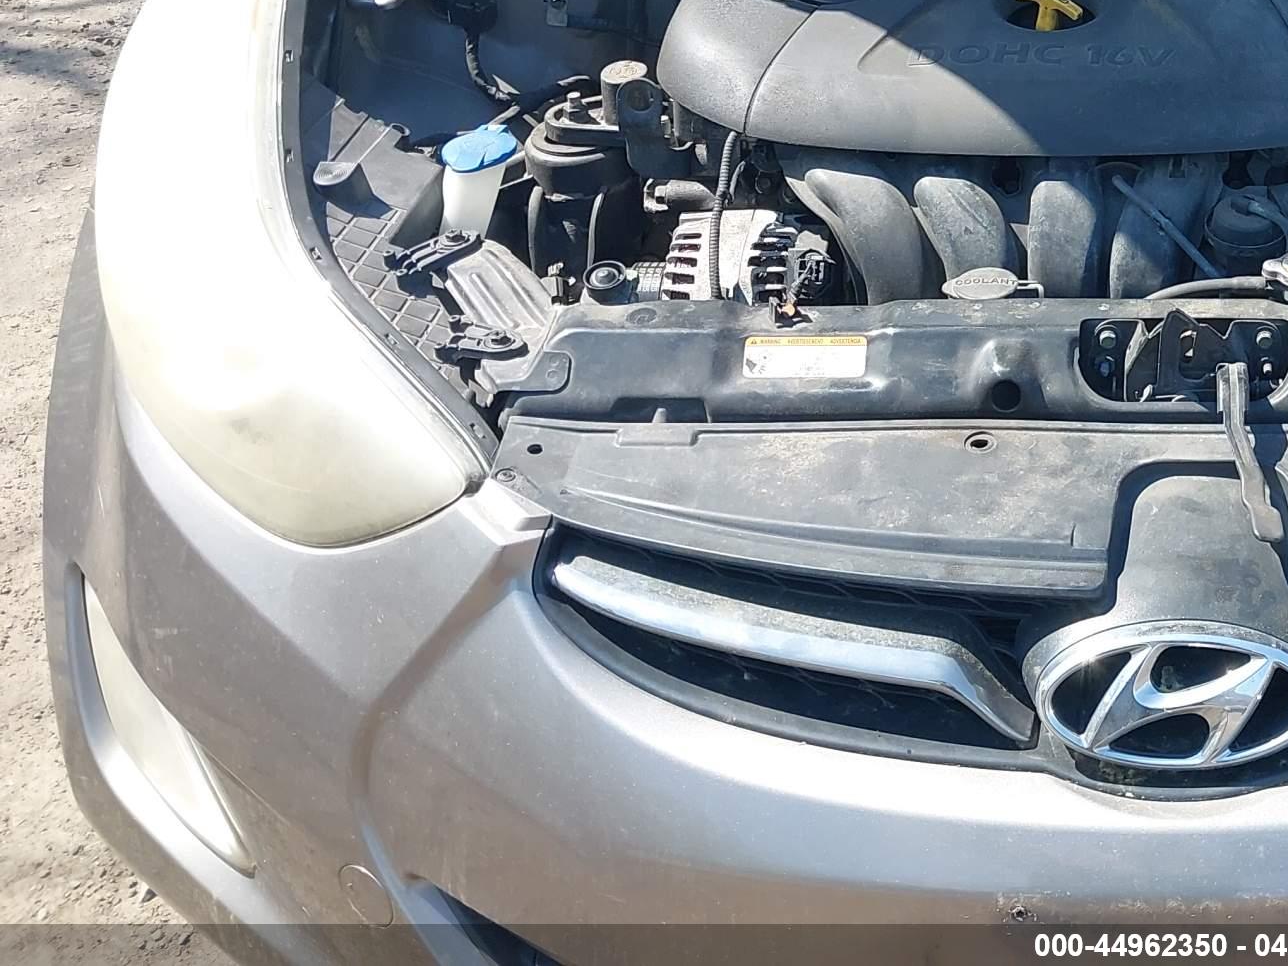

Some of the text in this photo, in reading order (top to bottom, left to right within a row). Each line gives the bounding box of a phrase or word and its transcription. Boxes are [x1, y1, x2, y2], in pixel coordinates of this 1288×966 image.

[907, 42, 1176, 68] DOHC 16V
[955, 277, 1018, 286] COOLANT
